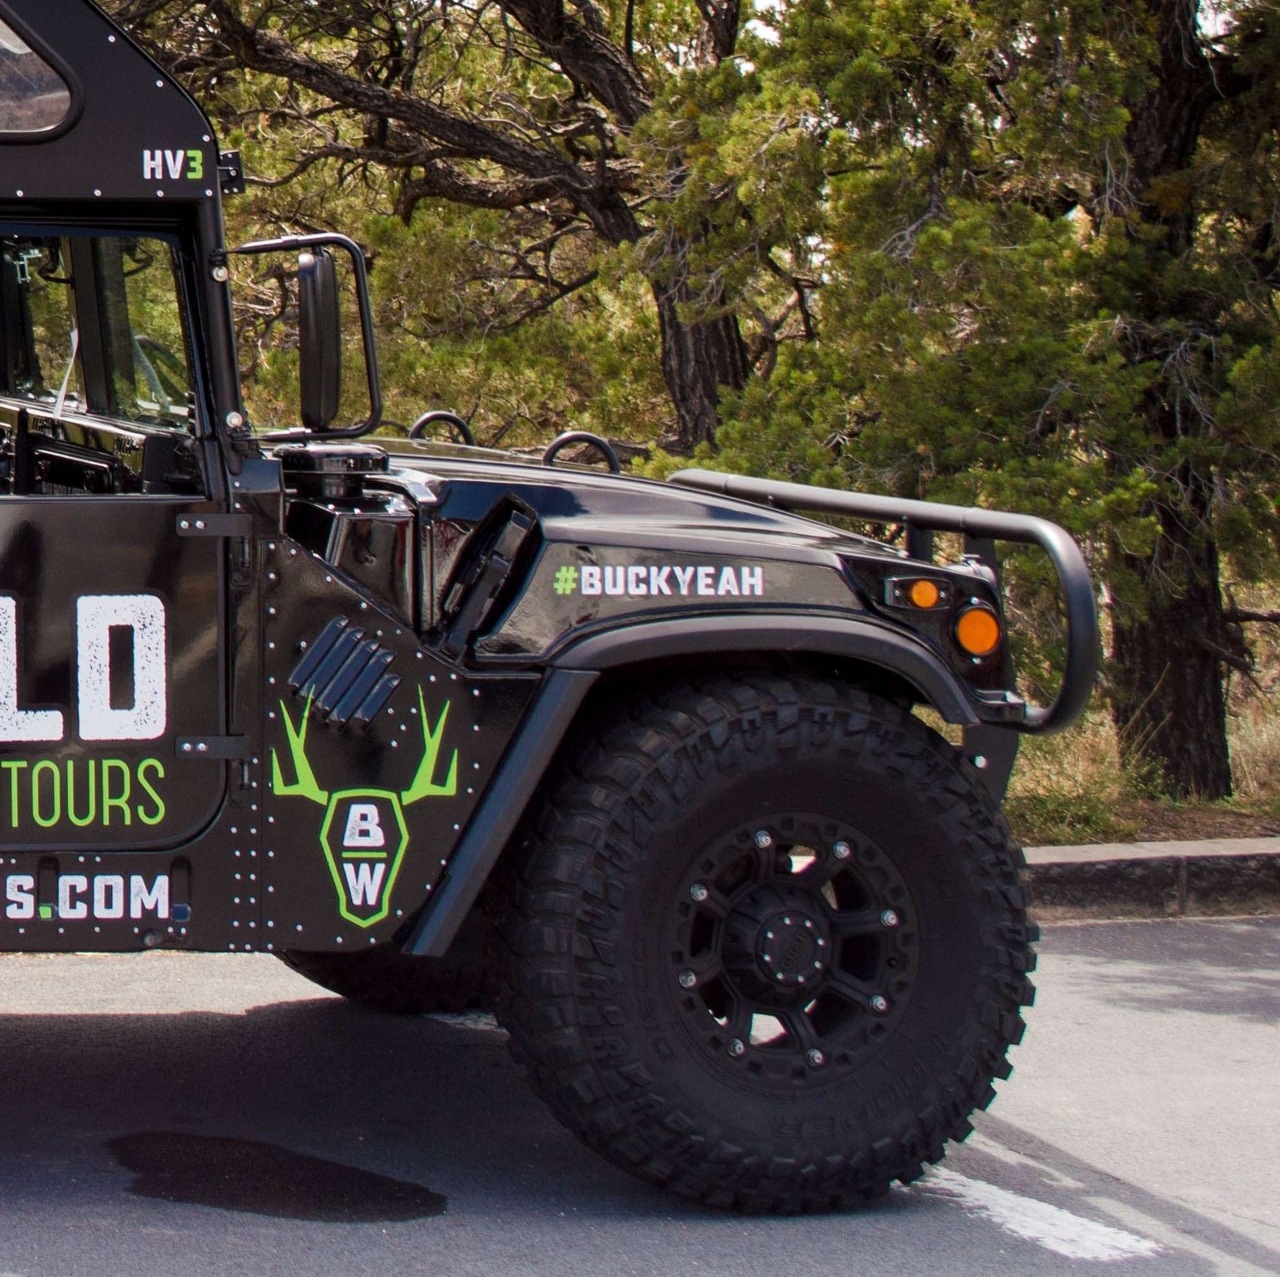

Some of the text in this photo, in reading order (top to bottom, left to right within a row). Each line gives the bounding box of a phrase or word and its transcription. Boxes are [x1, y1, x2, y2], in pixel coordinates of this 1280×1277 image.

[144, 150, 202, 179] HV3
[554, 566, 763, 595] #BUCKYEAH
[1, 758, 165, 827] TOURS
[344, 805, 384, 846] B
[343, 863, 385, 905] W
